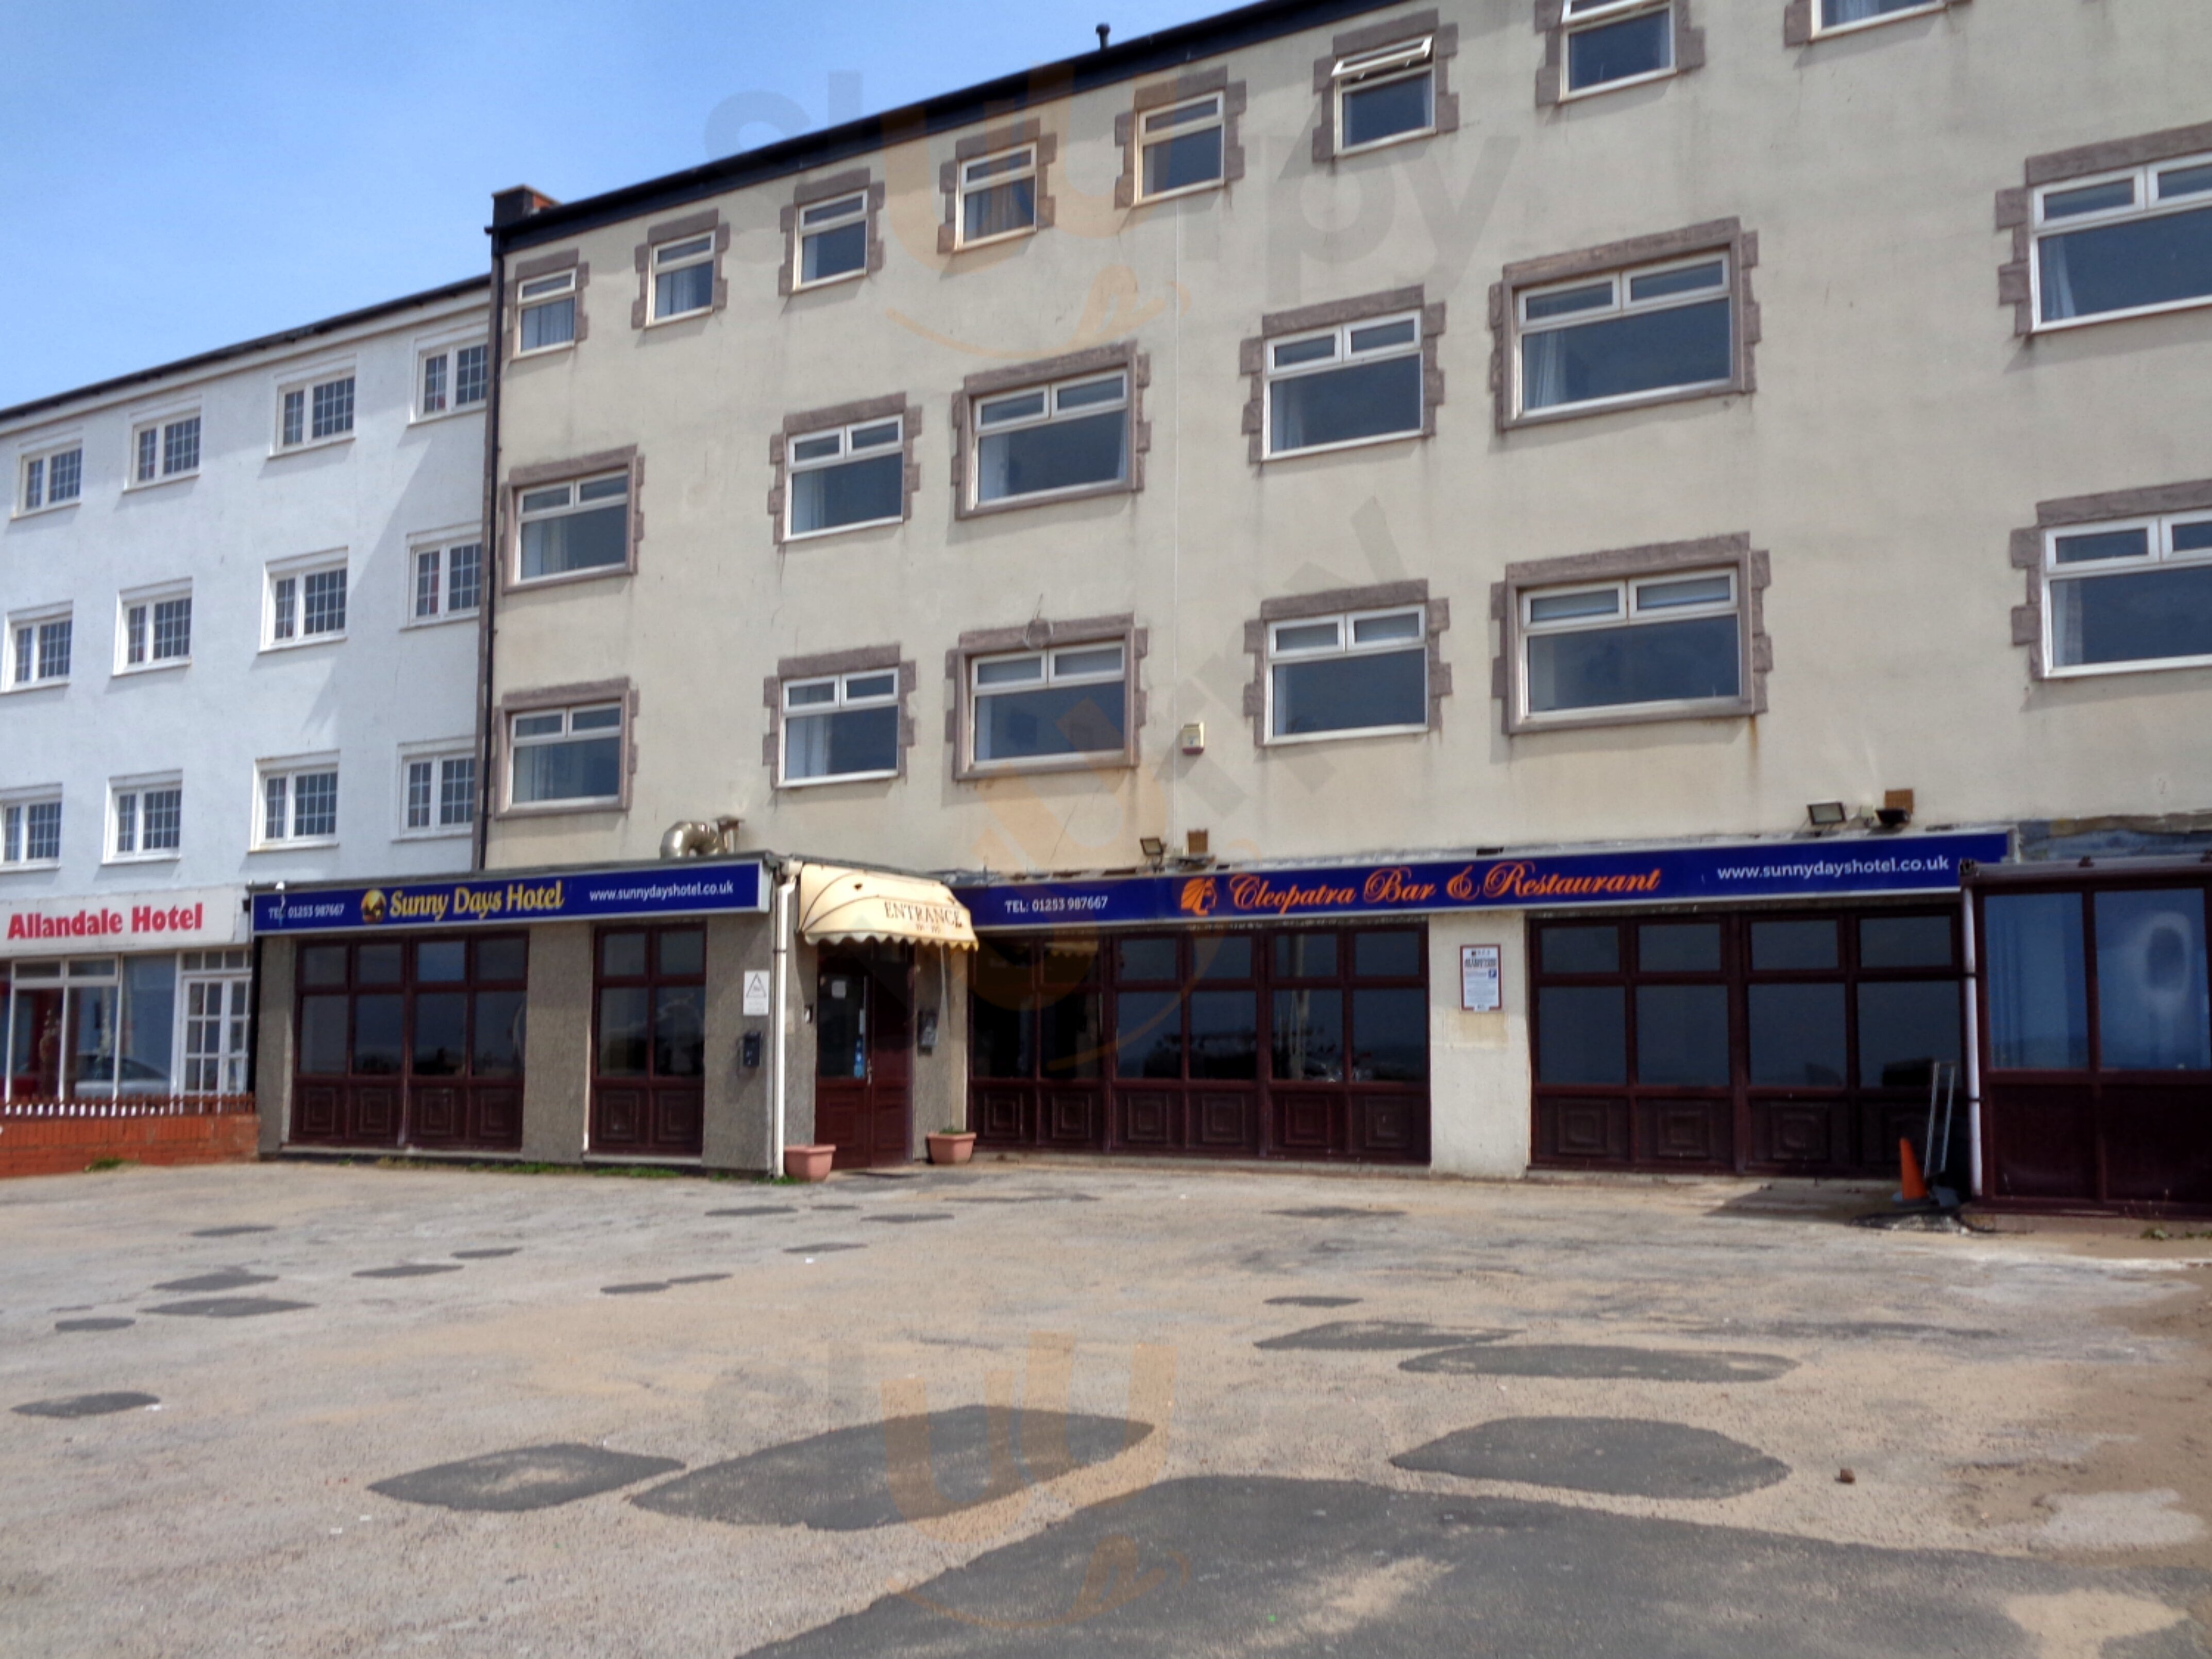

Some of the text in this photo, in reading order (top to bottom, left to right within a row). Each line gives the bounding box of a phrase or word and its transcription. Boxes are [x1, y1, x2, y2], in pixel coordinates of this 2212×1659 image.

[1717, 855, 1950, 879] www.sunnydayshotel.co.uk
[589, 879, 734, 902] www.sunnydayshotel.co.uk
[1229, 860, 1662, 915] Cleopatra Bar & Restaurant
[288, 905, 313, 918] 01253
[389, 880, 565, 921] Sunny Days Hotel
[1005, 895, 1108, 913] TEL: 01253 987667
[7, 902, 204, 939] Allandale Hotel
[884, 901, 963, 928] ENTRANCE
